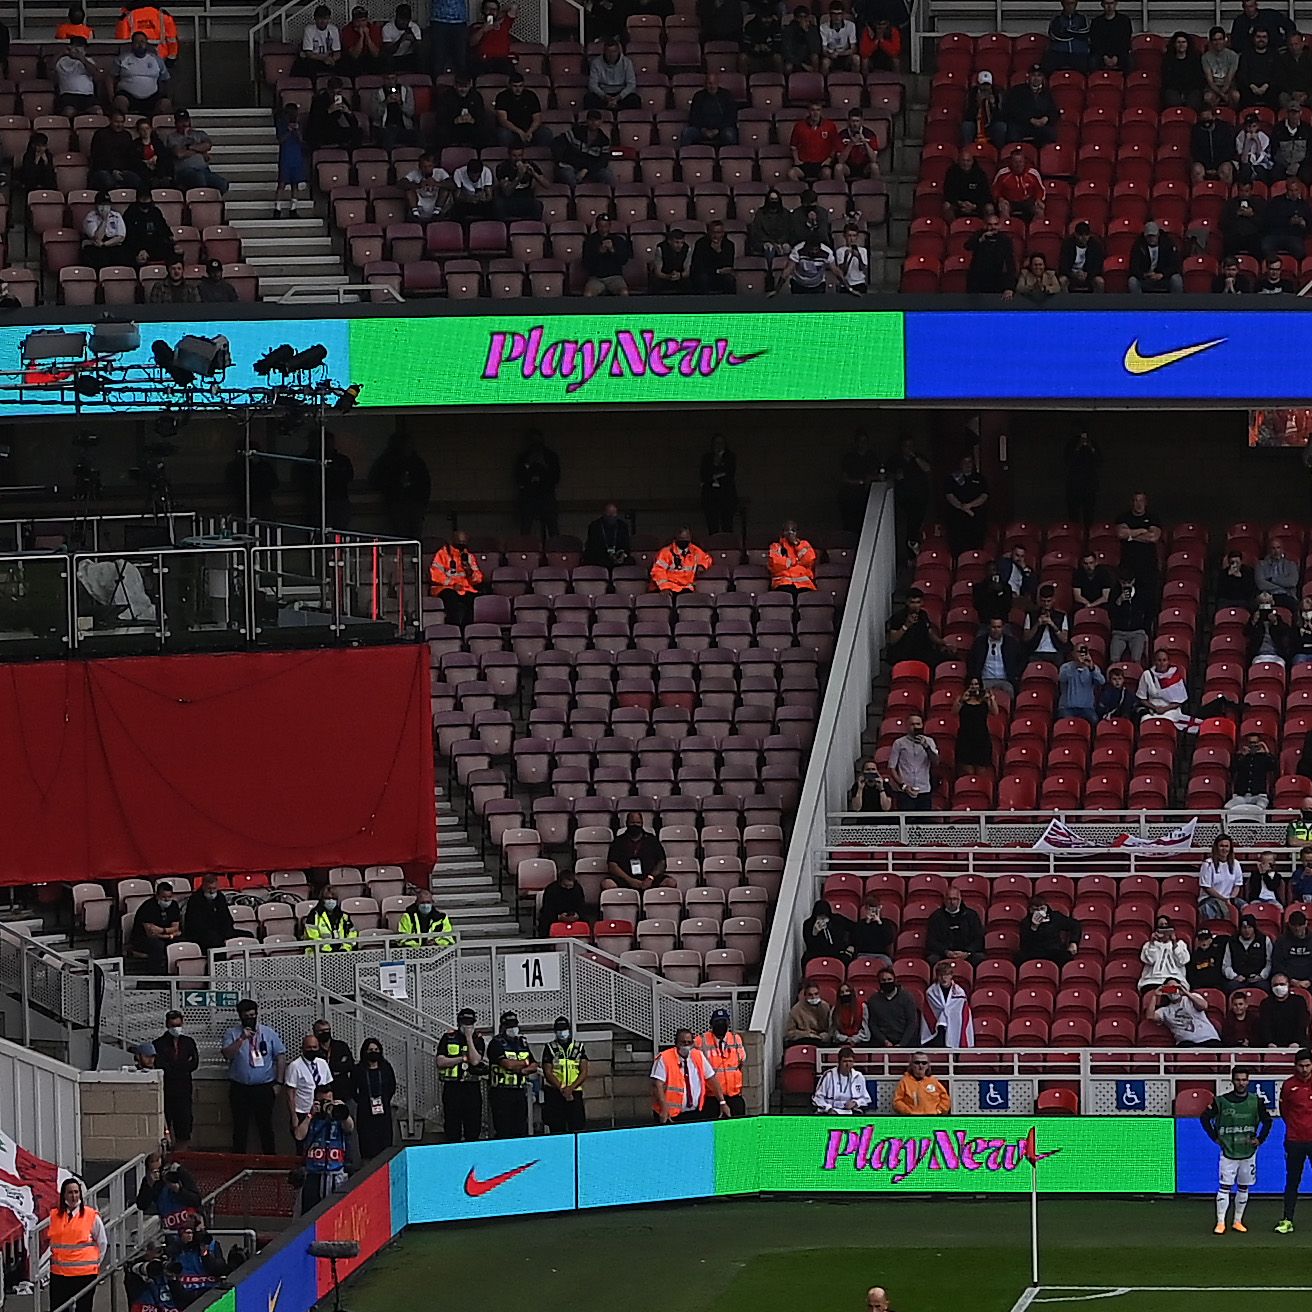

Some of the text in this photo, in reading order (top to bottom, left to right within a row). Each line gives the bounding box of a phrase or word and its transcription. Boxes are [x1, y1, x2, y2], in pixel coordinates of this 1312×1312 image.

[480, 325, 729, 394] PlayNew
[521, 958, 544, 988] 1A
[821, 1124, 1028, 1184] PlayNew
